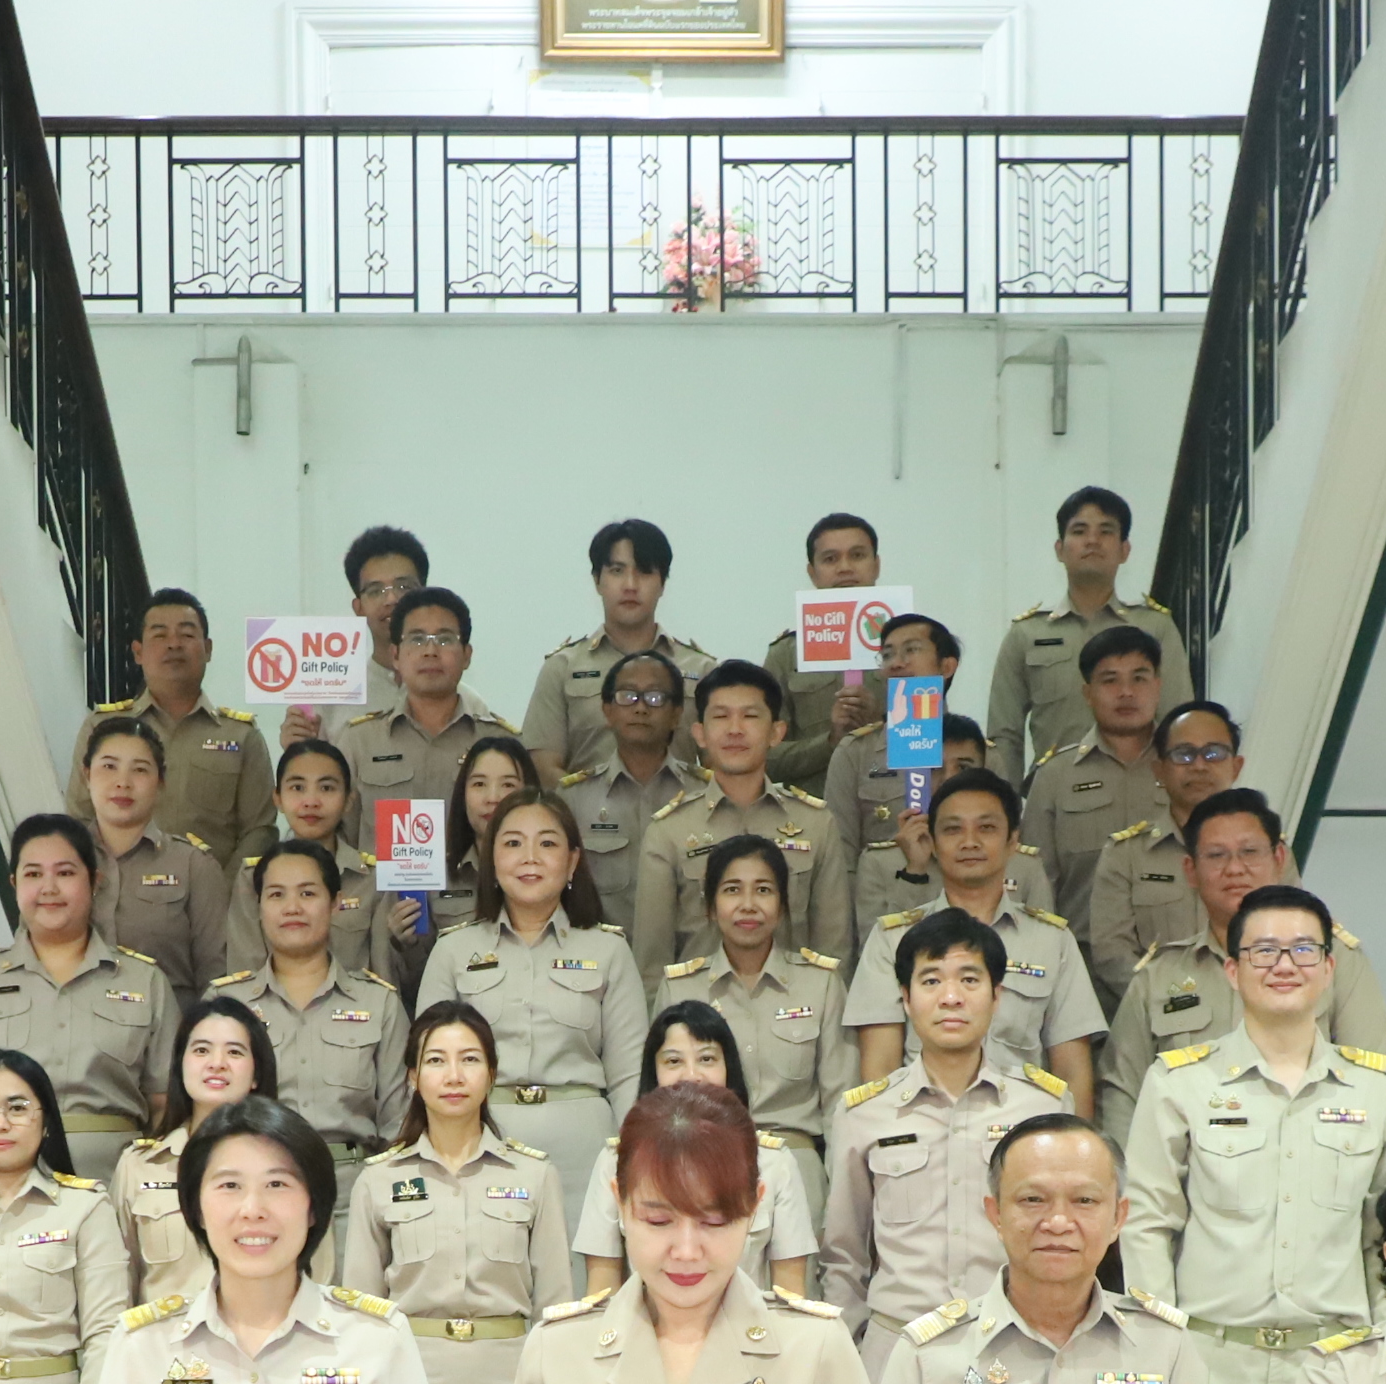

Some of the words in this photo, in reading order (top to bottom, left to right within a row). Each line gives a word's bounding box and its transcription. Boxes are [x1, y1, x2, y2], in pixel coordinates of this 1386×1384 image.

[805, 614, 822, 626] No
[824, 611, 845, 625] Gift
[302, 631, 361, 657] NO!
[806, 629, 845, 644] Policy
[301, 662, 318, 672] Gift
[321, 662, 349, 675] Policy
[393, 847, 407, 857] Gift
[409, 847, 433, 859] Policy
